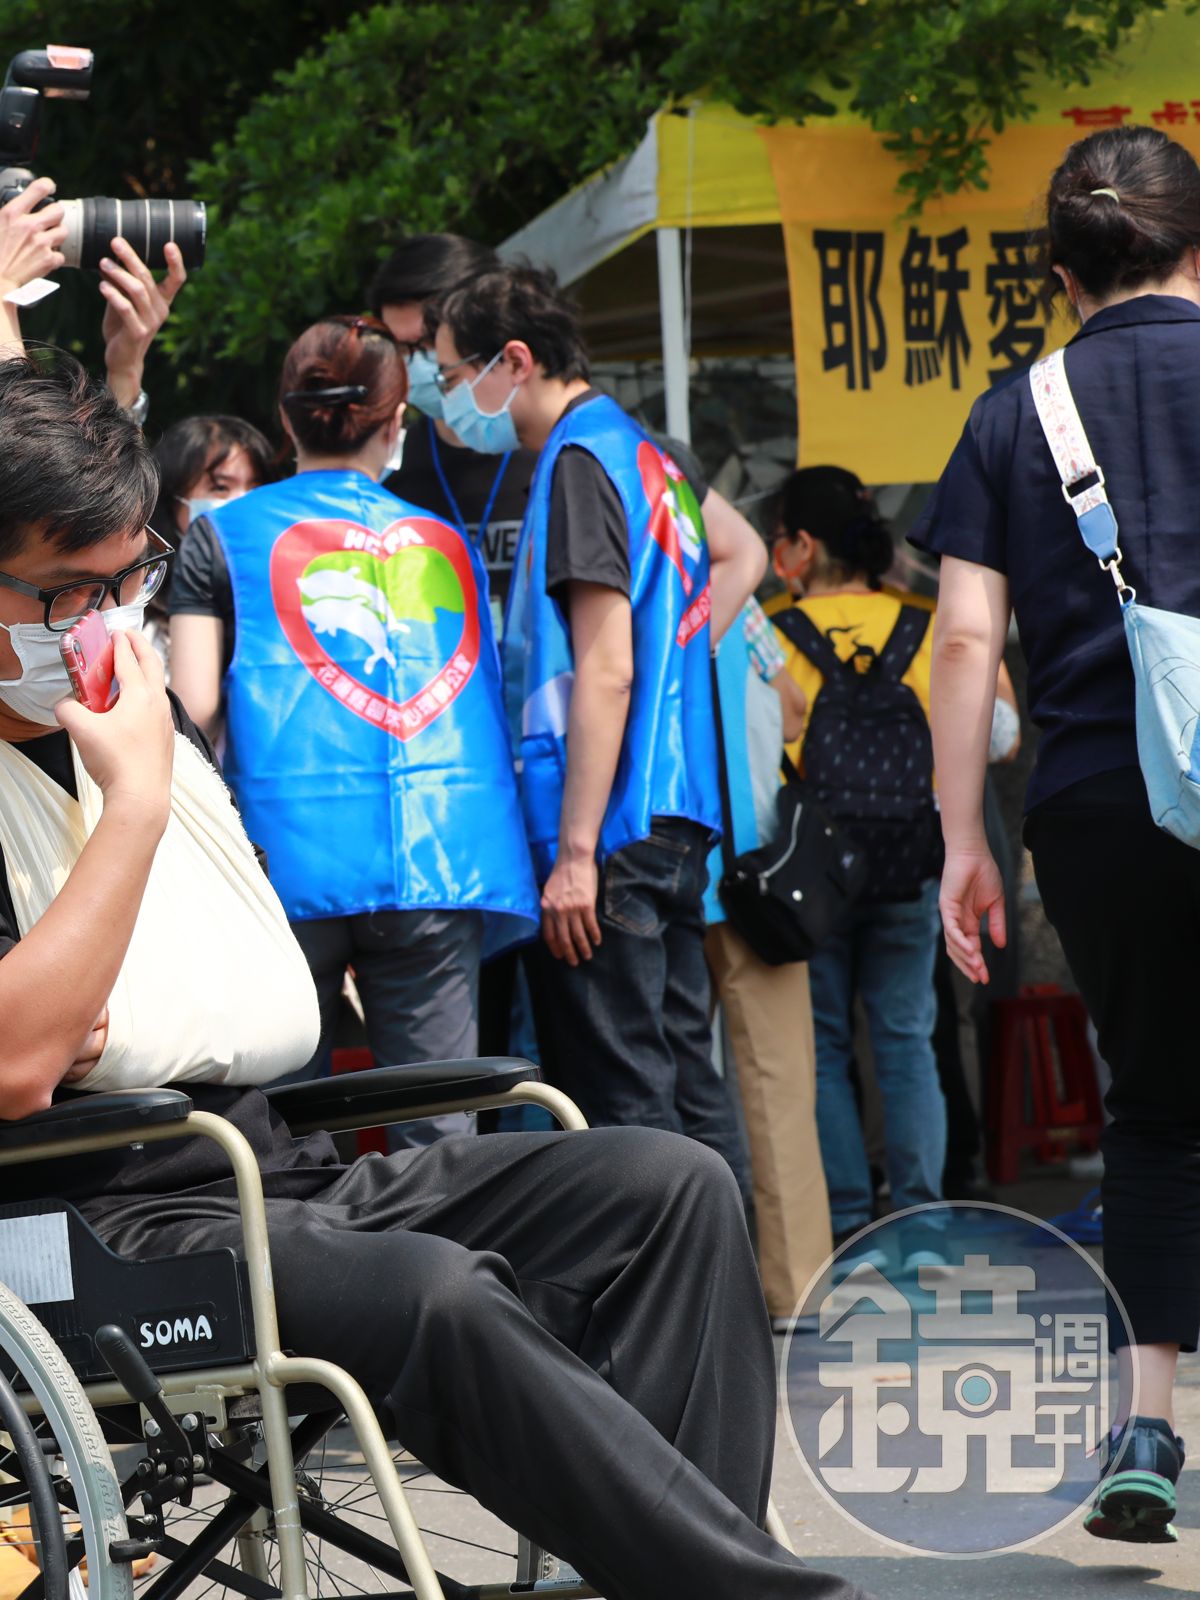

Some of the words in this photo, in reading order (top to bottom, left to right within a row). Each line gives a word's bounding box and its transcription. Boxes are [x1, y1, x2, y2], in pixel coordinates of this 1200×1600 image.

[813, 226, 1049, 391] 耶穌愛
[140, 1314, 213, 1348] SOMA
